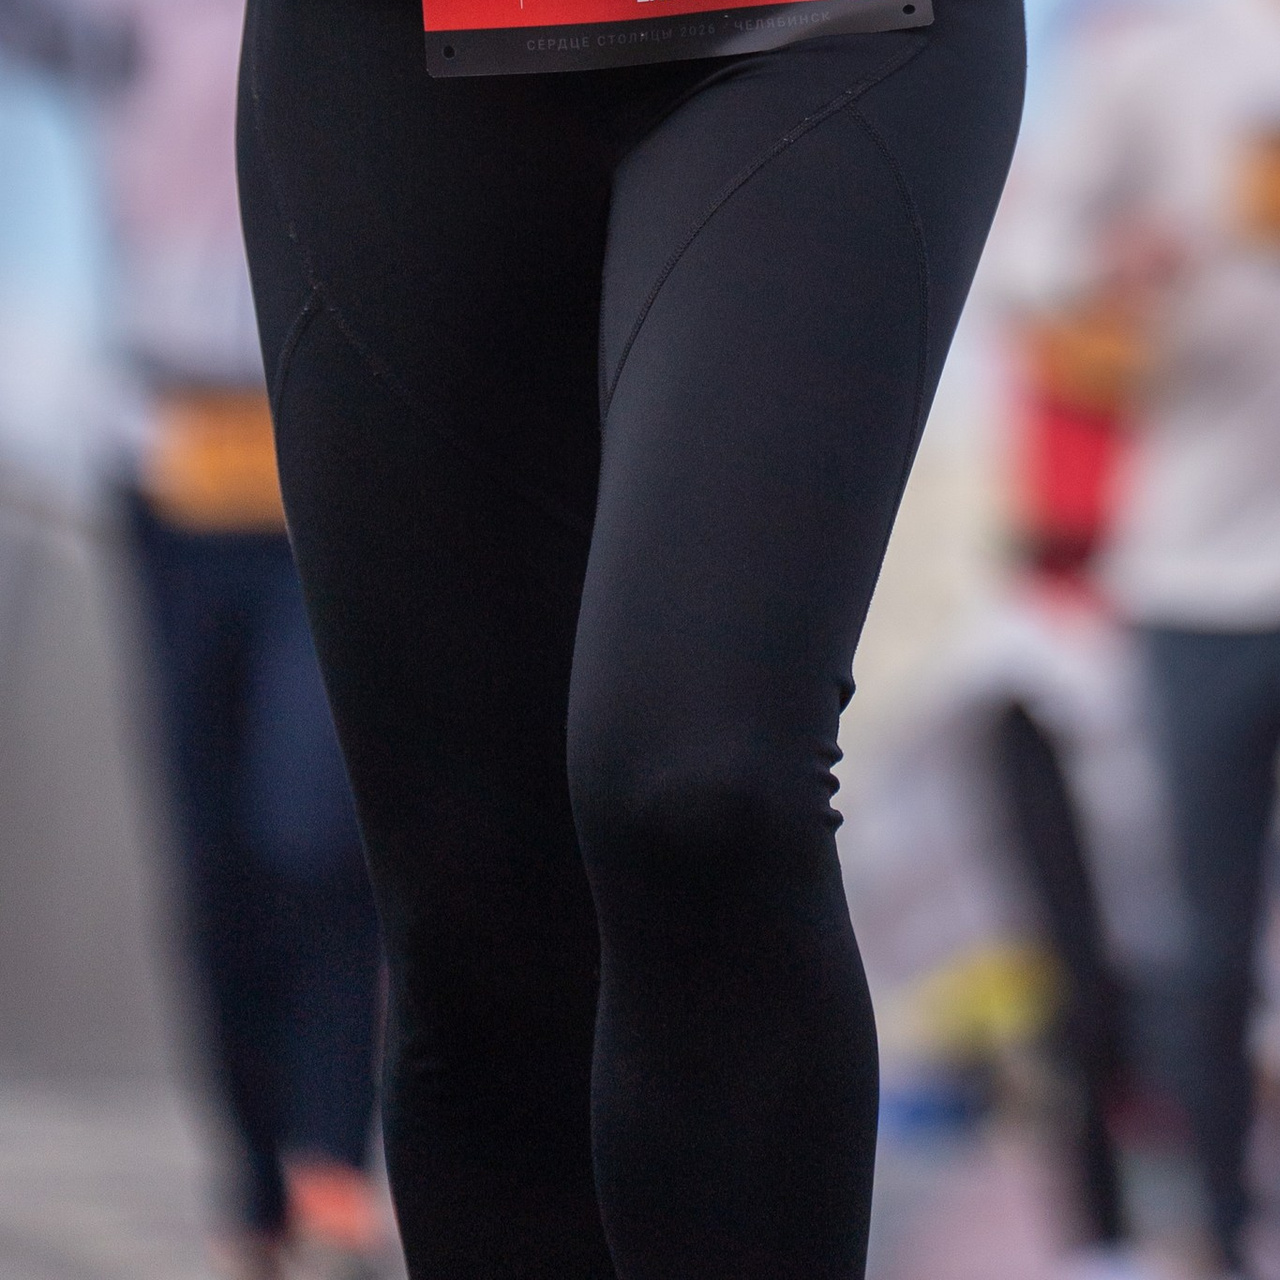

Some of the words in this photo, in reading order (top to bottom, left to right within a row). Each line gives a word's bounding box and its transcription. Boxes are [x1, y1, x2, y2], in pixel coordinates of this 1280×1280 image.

[526, 36, 591, 52] СЕРДЦЕ
[597, 28, 673, 47] СТОЛИЦЫ
[734, 11, 831, 32] ЧЕЛЯБИНСК
